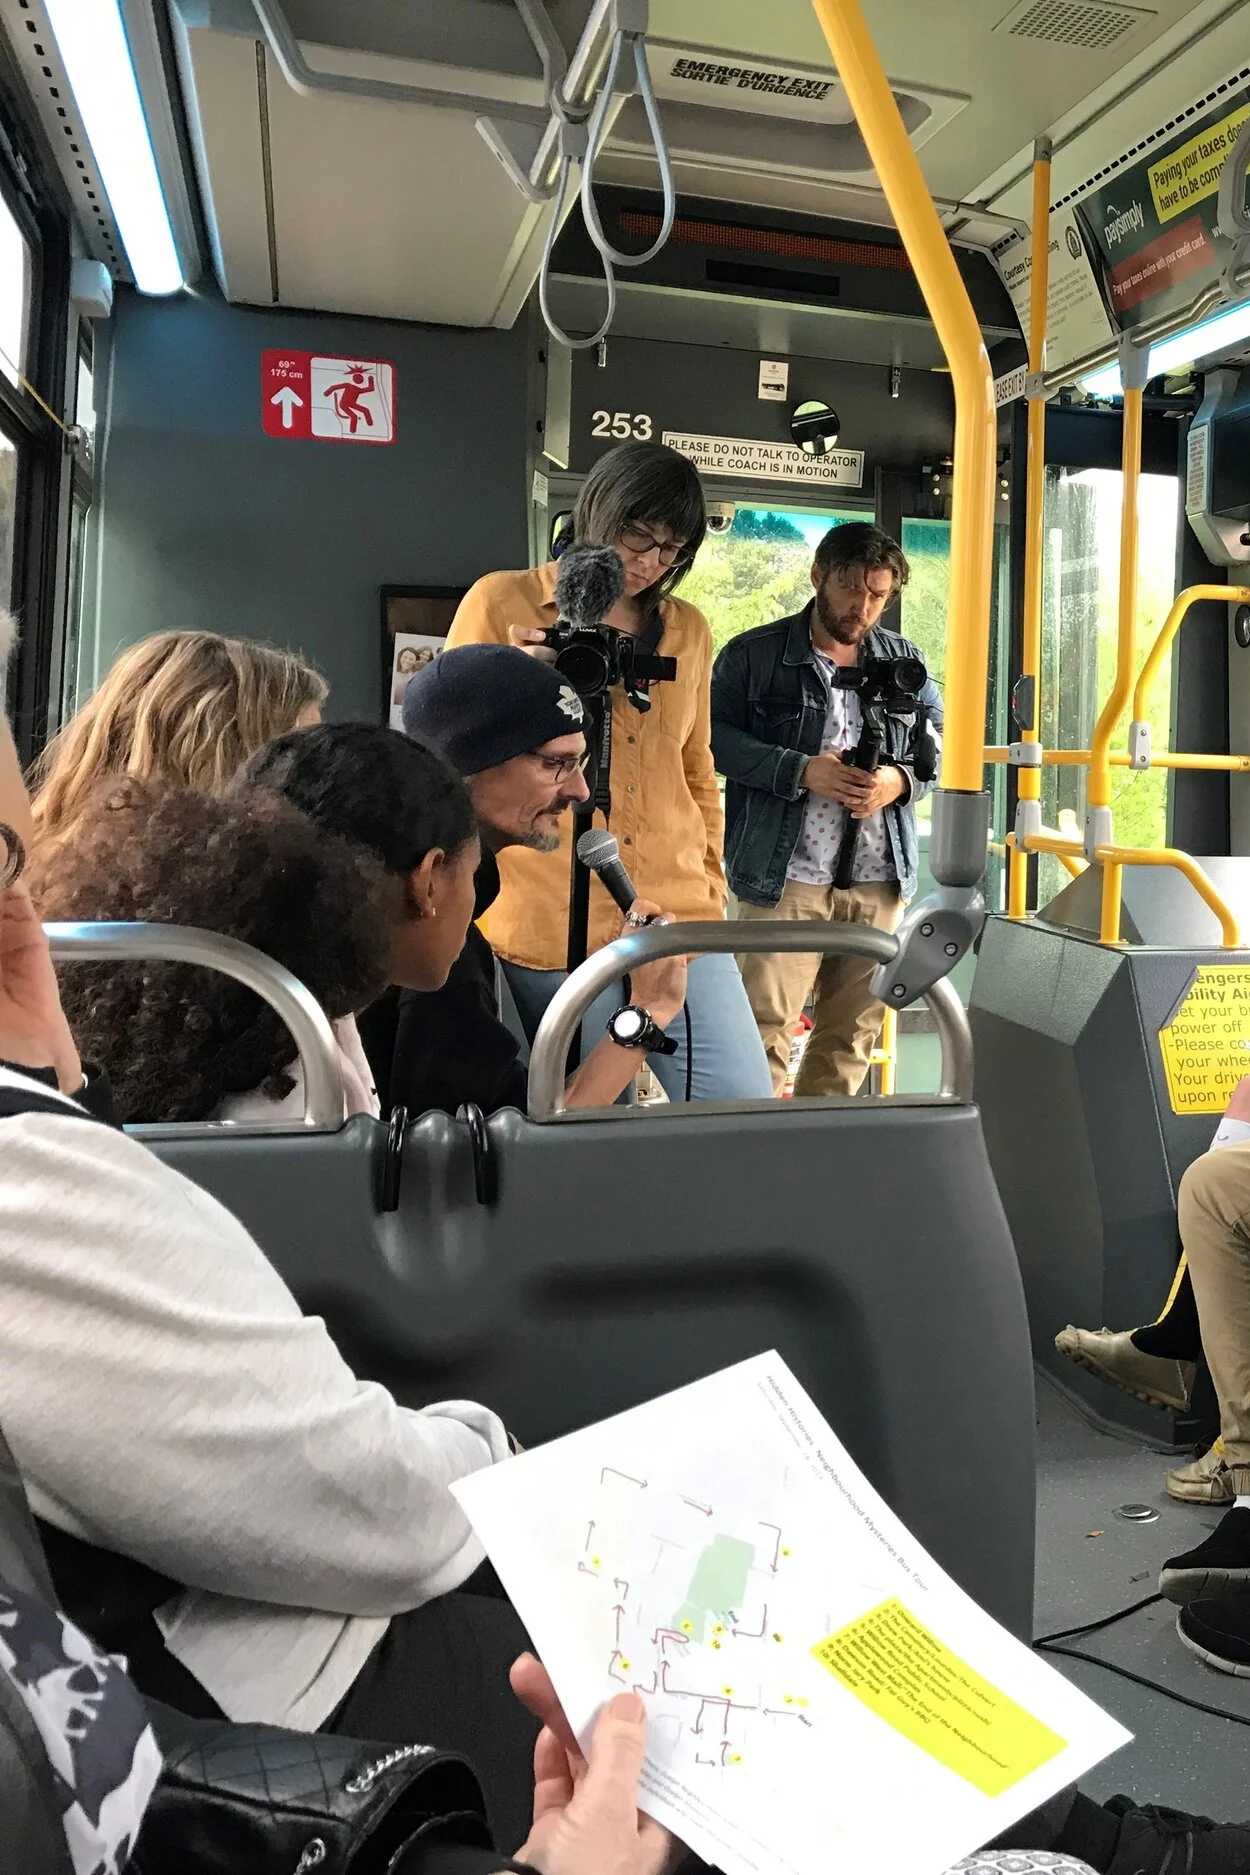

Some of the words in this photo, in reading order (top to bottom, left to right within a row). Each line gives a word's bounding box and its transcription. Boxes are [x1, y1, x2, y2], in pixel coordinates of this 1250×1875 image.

[670, 68, 734, 86] SORTIE
[736, 79, 828, 100] D'URGENCE
[675, 58, 790, 85] EMERGENCY
[791, 77, 834, 91] EXIT
[1152, 164, 1183, 189] Paying
[1182, 151, 1199, 177] your
[1198, 134, 1227, 159] taxes
[1159, 191, 1179, 212] have
[1179, 184, 1189, 201] to
[1188, 177, 1200, 195] be
[1103, 199, 1145, 249] paysimply
[1112, 283, 1123, 295] Pay
[1122, 279, 1131, 293] your
[1131, 271, 1143, 285] taxes
[1142, 263, 1157, 278] online
[1156, 256, 1167, 270] with
[1165, 252, 1176, 268] your
[1176, 241, 1192, 258] credit
[270, 368, 287, 378] 175
[591, 410, 652, 440] 253
[668, 439, 710, 452] PLEASE
[713, 443, 730, 455] DO
[731, 445, 756, 457] NOT
[757, 448, 784, 461] TALK
[785, 451, 800, 462] TO
[802, 452, 859, 468] OPERATOR
[689, 455, 724, 469] WHILE
[727, 458, 766, 472] COACH
[769, 461, 780, 473] IS
[783, 463, 794, 474] IN
[796, 465, 839, 479] MOTION
[600, 709, 611, 768] Manfrotto
[1176, 1005, 1195, 1017] et
[1200, 1007, 1233, 1019] your
[1170, 1023, 1217, 1037] power
[1223, 1020, 1243, 1033] off
[1169, 1038, 1224, 1051] -Please
[1177, 1056, 1211, 1070] your
[1173, 1073, 1212, 1085] Your
[1178, 1090, 1217, 1104] upon
[767, 1376, 788, 1406] Hidden
[816, 1450, 865, 1516] Neighbourhood
[864, 1517, 896, 1556] Mysteries
[897, 1557, 910, 1572] Bus
[912, 1573, 928, 1591] Tour
[874, 1624, 885, 1636] The
[890, 1614, 901, 1626] The
[897, 1610, 922, 1633] Onward
[921, 1633, 941, 1652] Willow
[834, 1650, 851, 1668] Norm
[865, 1680, 880, 1694] Park
[842, 1645, 866, 1669] Dawson
[858, 1636, 894, 1668] Applewood
[893, 1669, 920, 1693] Complex
[866, 1630, 886, 1650] Willow
[887, 1650, 904, 1665] Road
[903, 1665, 922, 1683] Public
[924, 1682, 947, 1701] School
[850, 1640, 870, 1660] Willow
[871, 1660, 887, 1675] West
[918, 1701, 932, 1713] End
[940, 1719, 951, 1728] the
